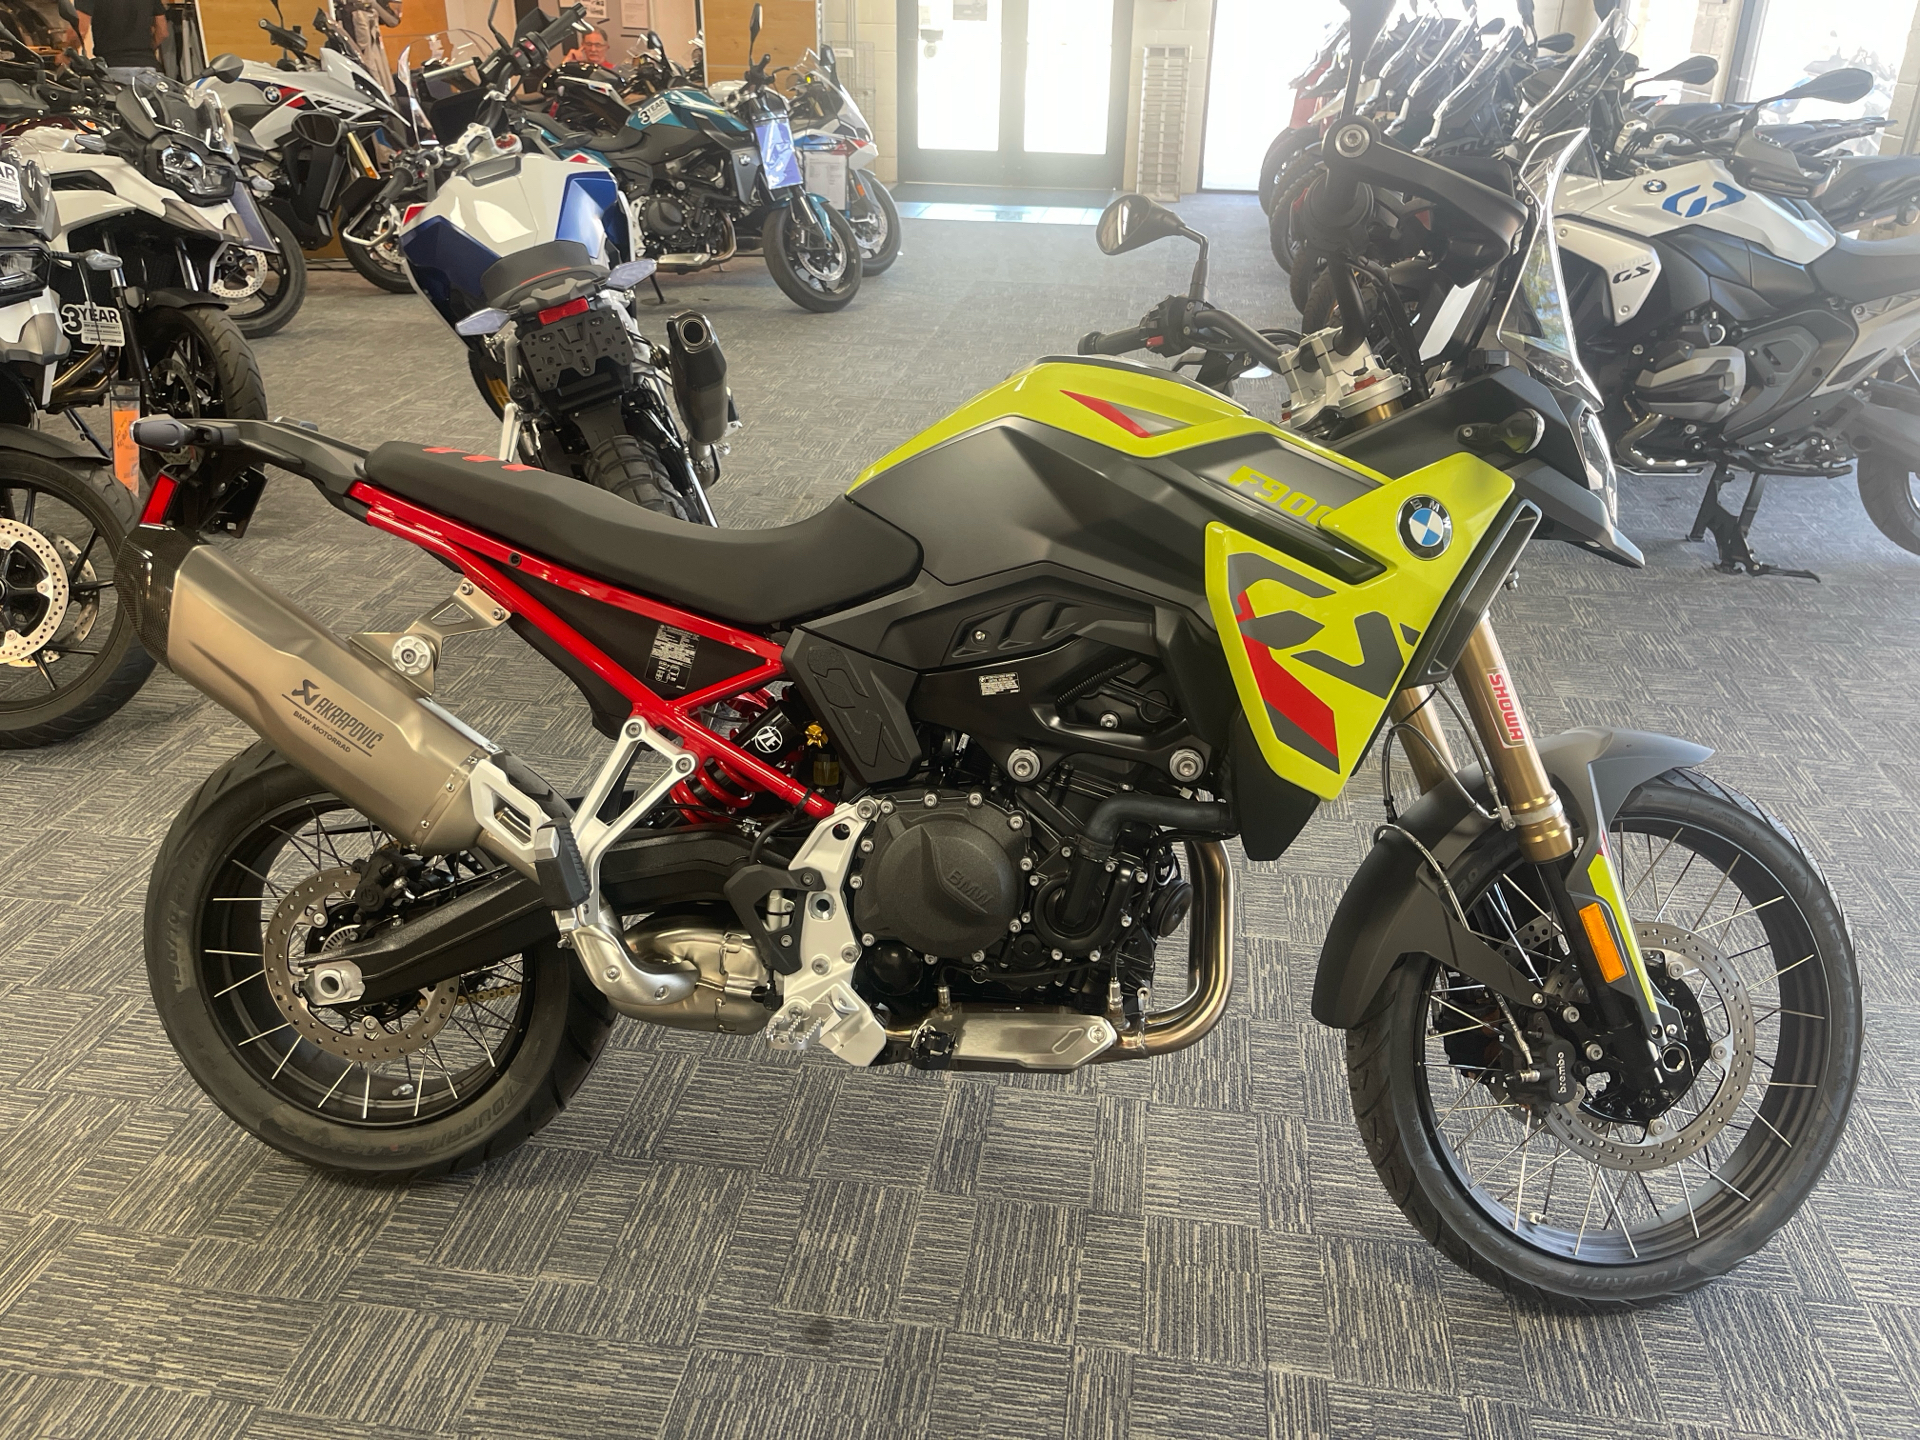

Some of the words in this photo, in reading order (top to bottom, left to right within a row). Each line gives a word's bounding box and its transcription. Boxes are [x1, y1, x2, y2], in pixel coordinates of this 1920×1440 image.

[640, 110, 650, 123] 3
[1612, 261, 1653, 284] GS
[63, 306, 82, 332] 3
[79, 308, 119, 324] YEAR
[1410, 499, 1452, 530] BMW
[1487, 673, 1526, 741] SHOWA
[293, 710, 313, 726] BMW
[311, 723, 352, 754] MOTORRAD
[947, 869, 994, 906] BMW
[1556, 1051, 1567, 1094] brembo
